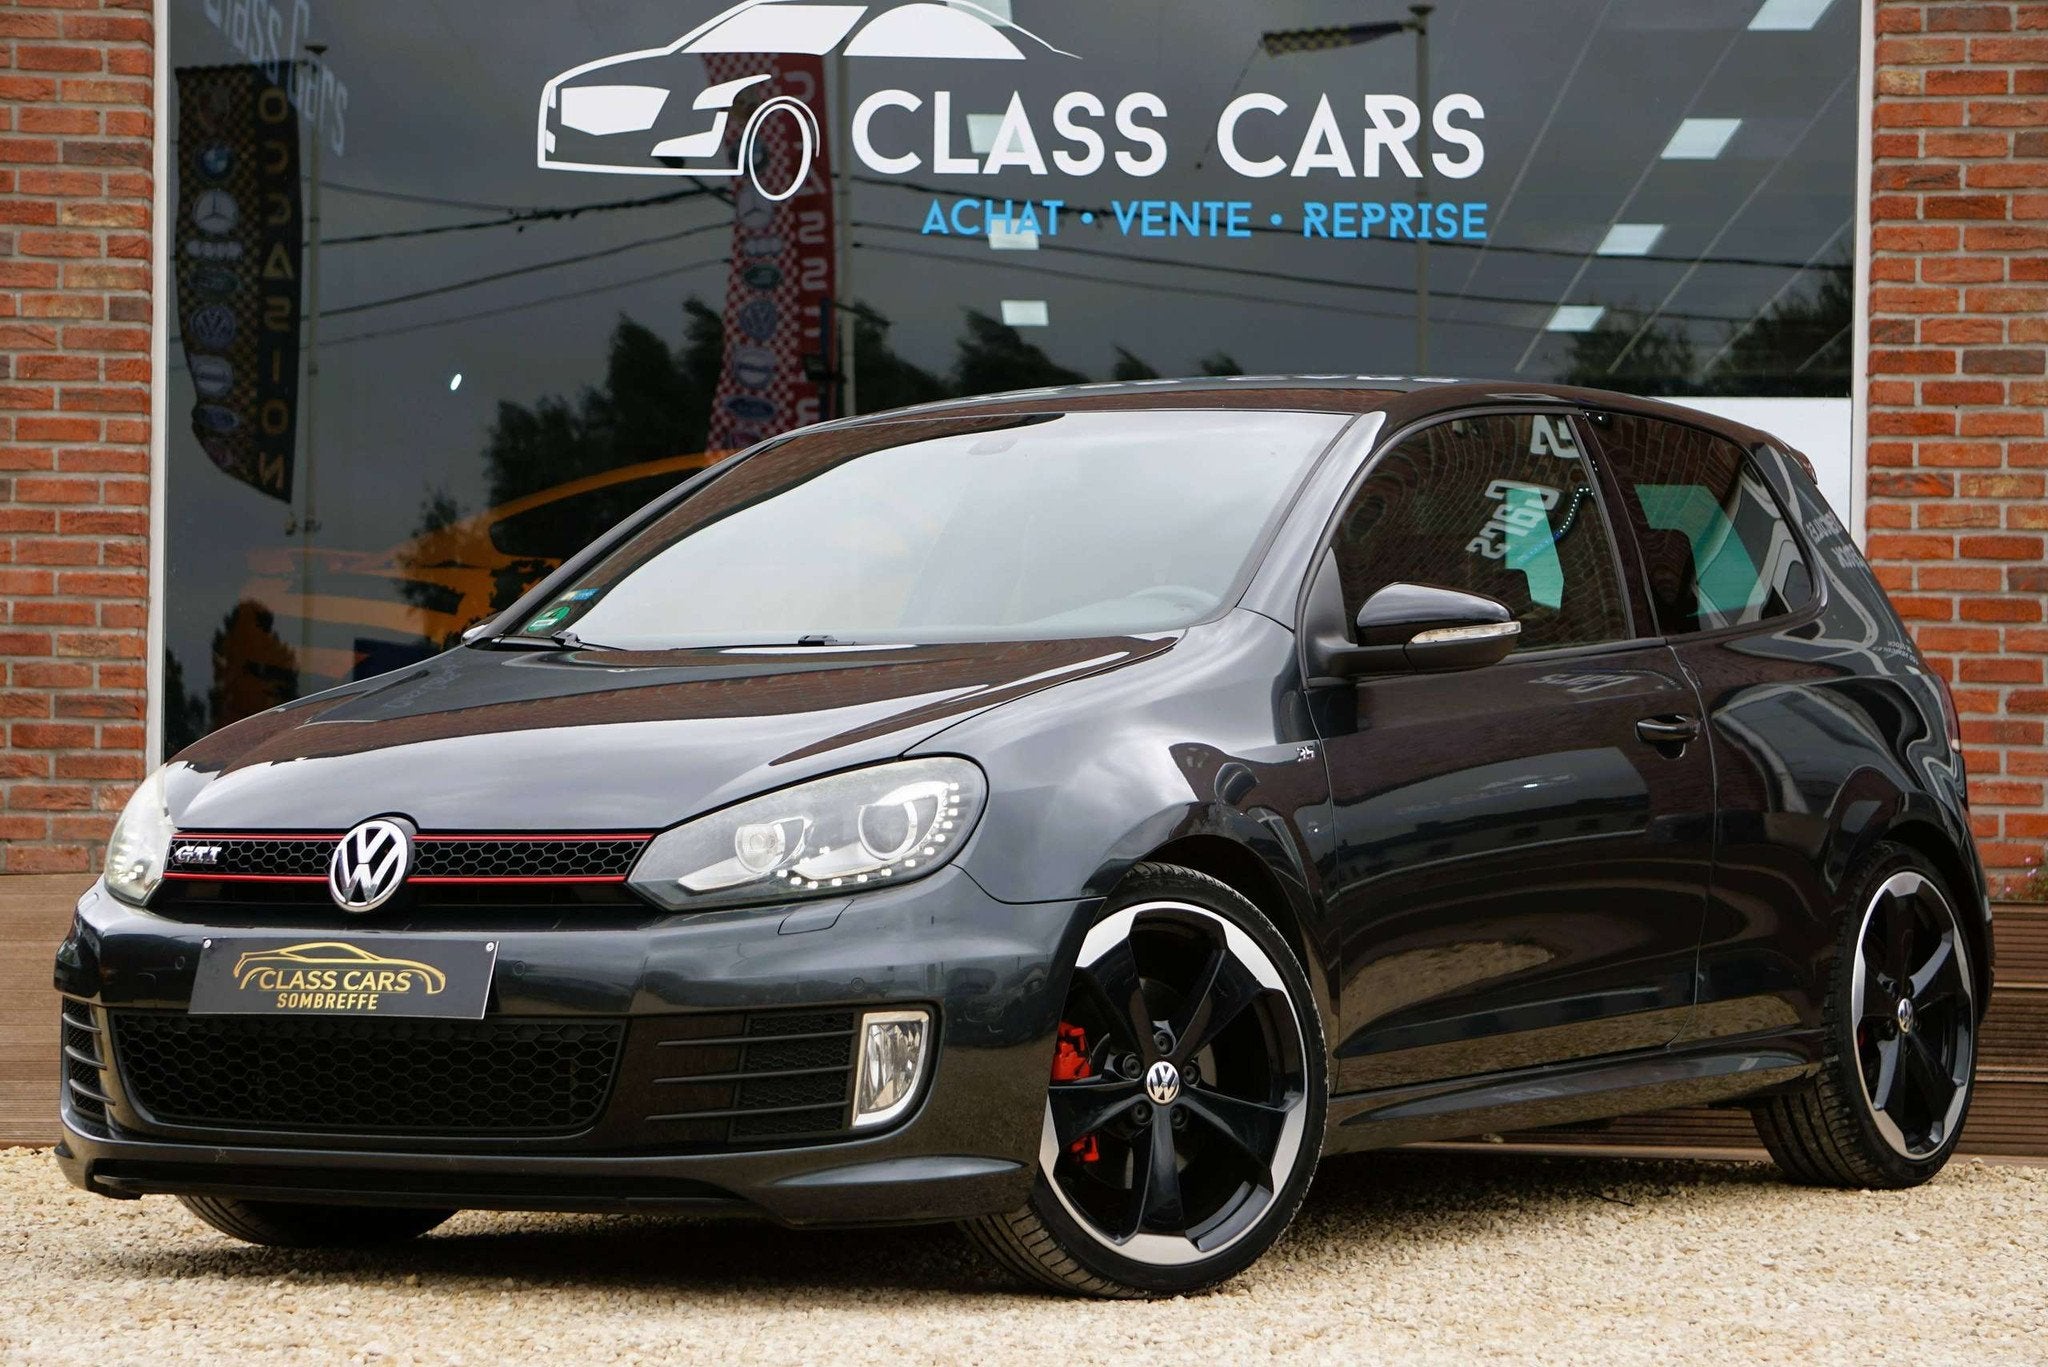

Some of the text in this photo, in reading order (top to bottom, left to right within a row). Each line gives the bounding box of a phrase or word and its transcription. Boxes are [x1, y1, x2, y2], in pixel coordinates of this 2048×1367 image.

[852, 89, 1486, 179] CLASS CARS
[922, 199, 1488, 239] ACHAT VENTE REPRISE
[174, 845, 223, 865] GTI
[259, 970, 412, 992] CLASS CARS
[276, 992, 380, 1010] SOMBREFFE
